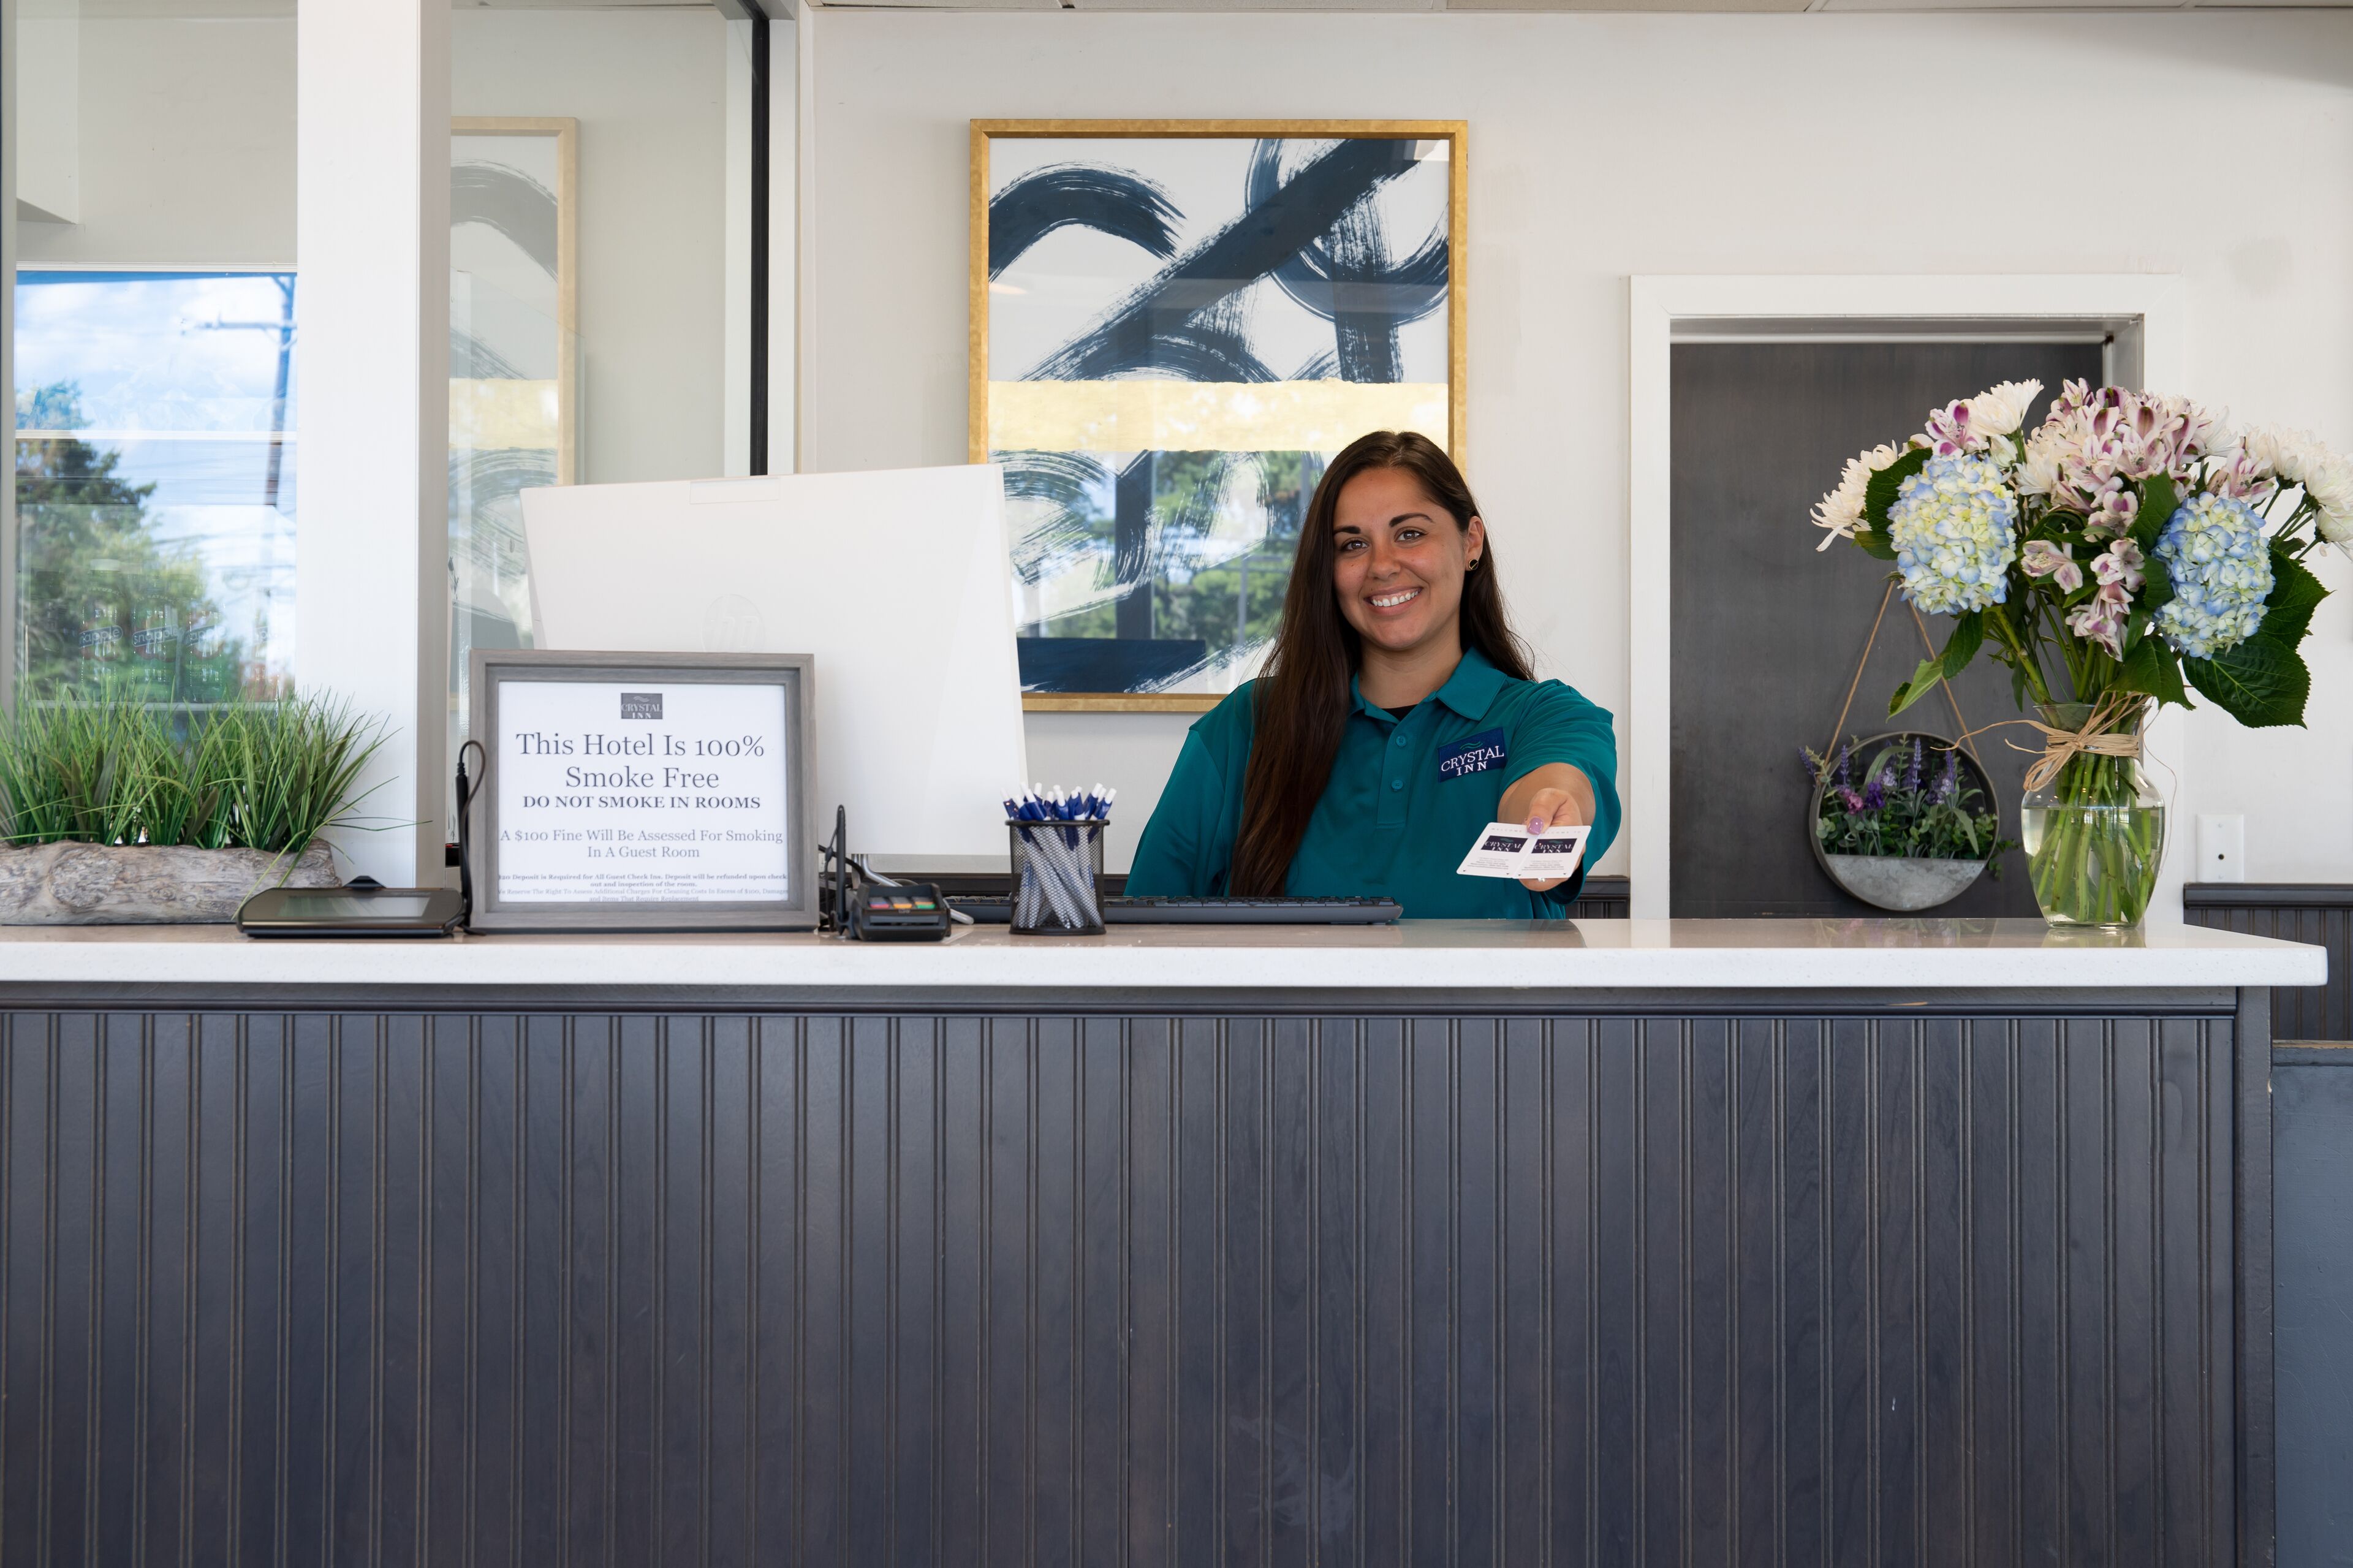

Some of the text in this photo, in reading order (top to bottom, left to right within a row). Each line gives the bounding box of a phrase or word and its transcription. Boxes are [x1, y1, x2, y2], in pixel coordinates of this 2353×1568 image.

[79, 626, 120, 645] napple
[621, 703, 662, 712] CRYSTAL
[516, 732, 764, 758] This Hotel Is 100%
[1441, 745, 1504, 772] CRYSTAL
[1456, 761, 1487, 776] INN
[566, 765, 719, 789] Smoke Free
[523, 795, 760, 809] DO NOT SMOKE IN ROOMS
[500, 829, 783, 844] A $100 Fine Will Be Assessed For Smoking
[588, 846, 700, 858] In A Guest Room
[1484, 840, 1522, 849] CRYSTAL
